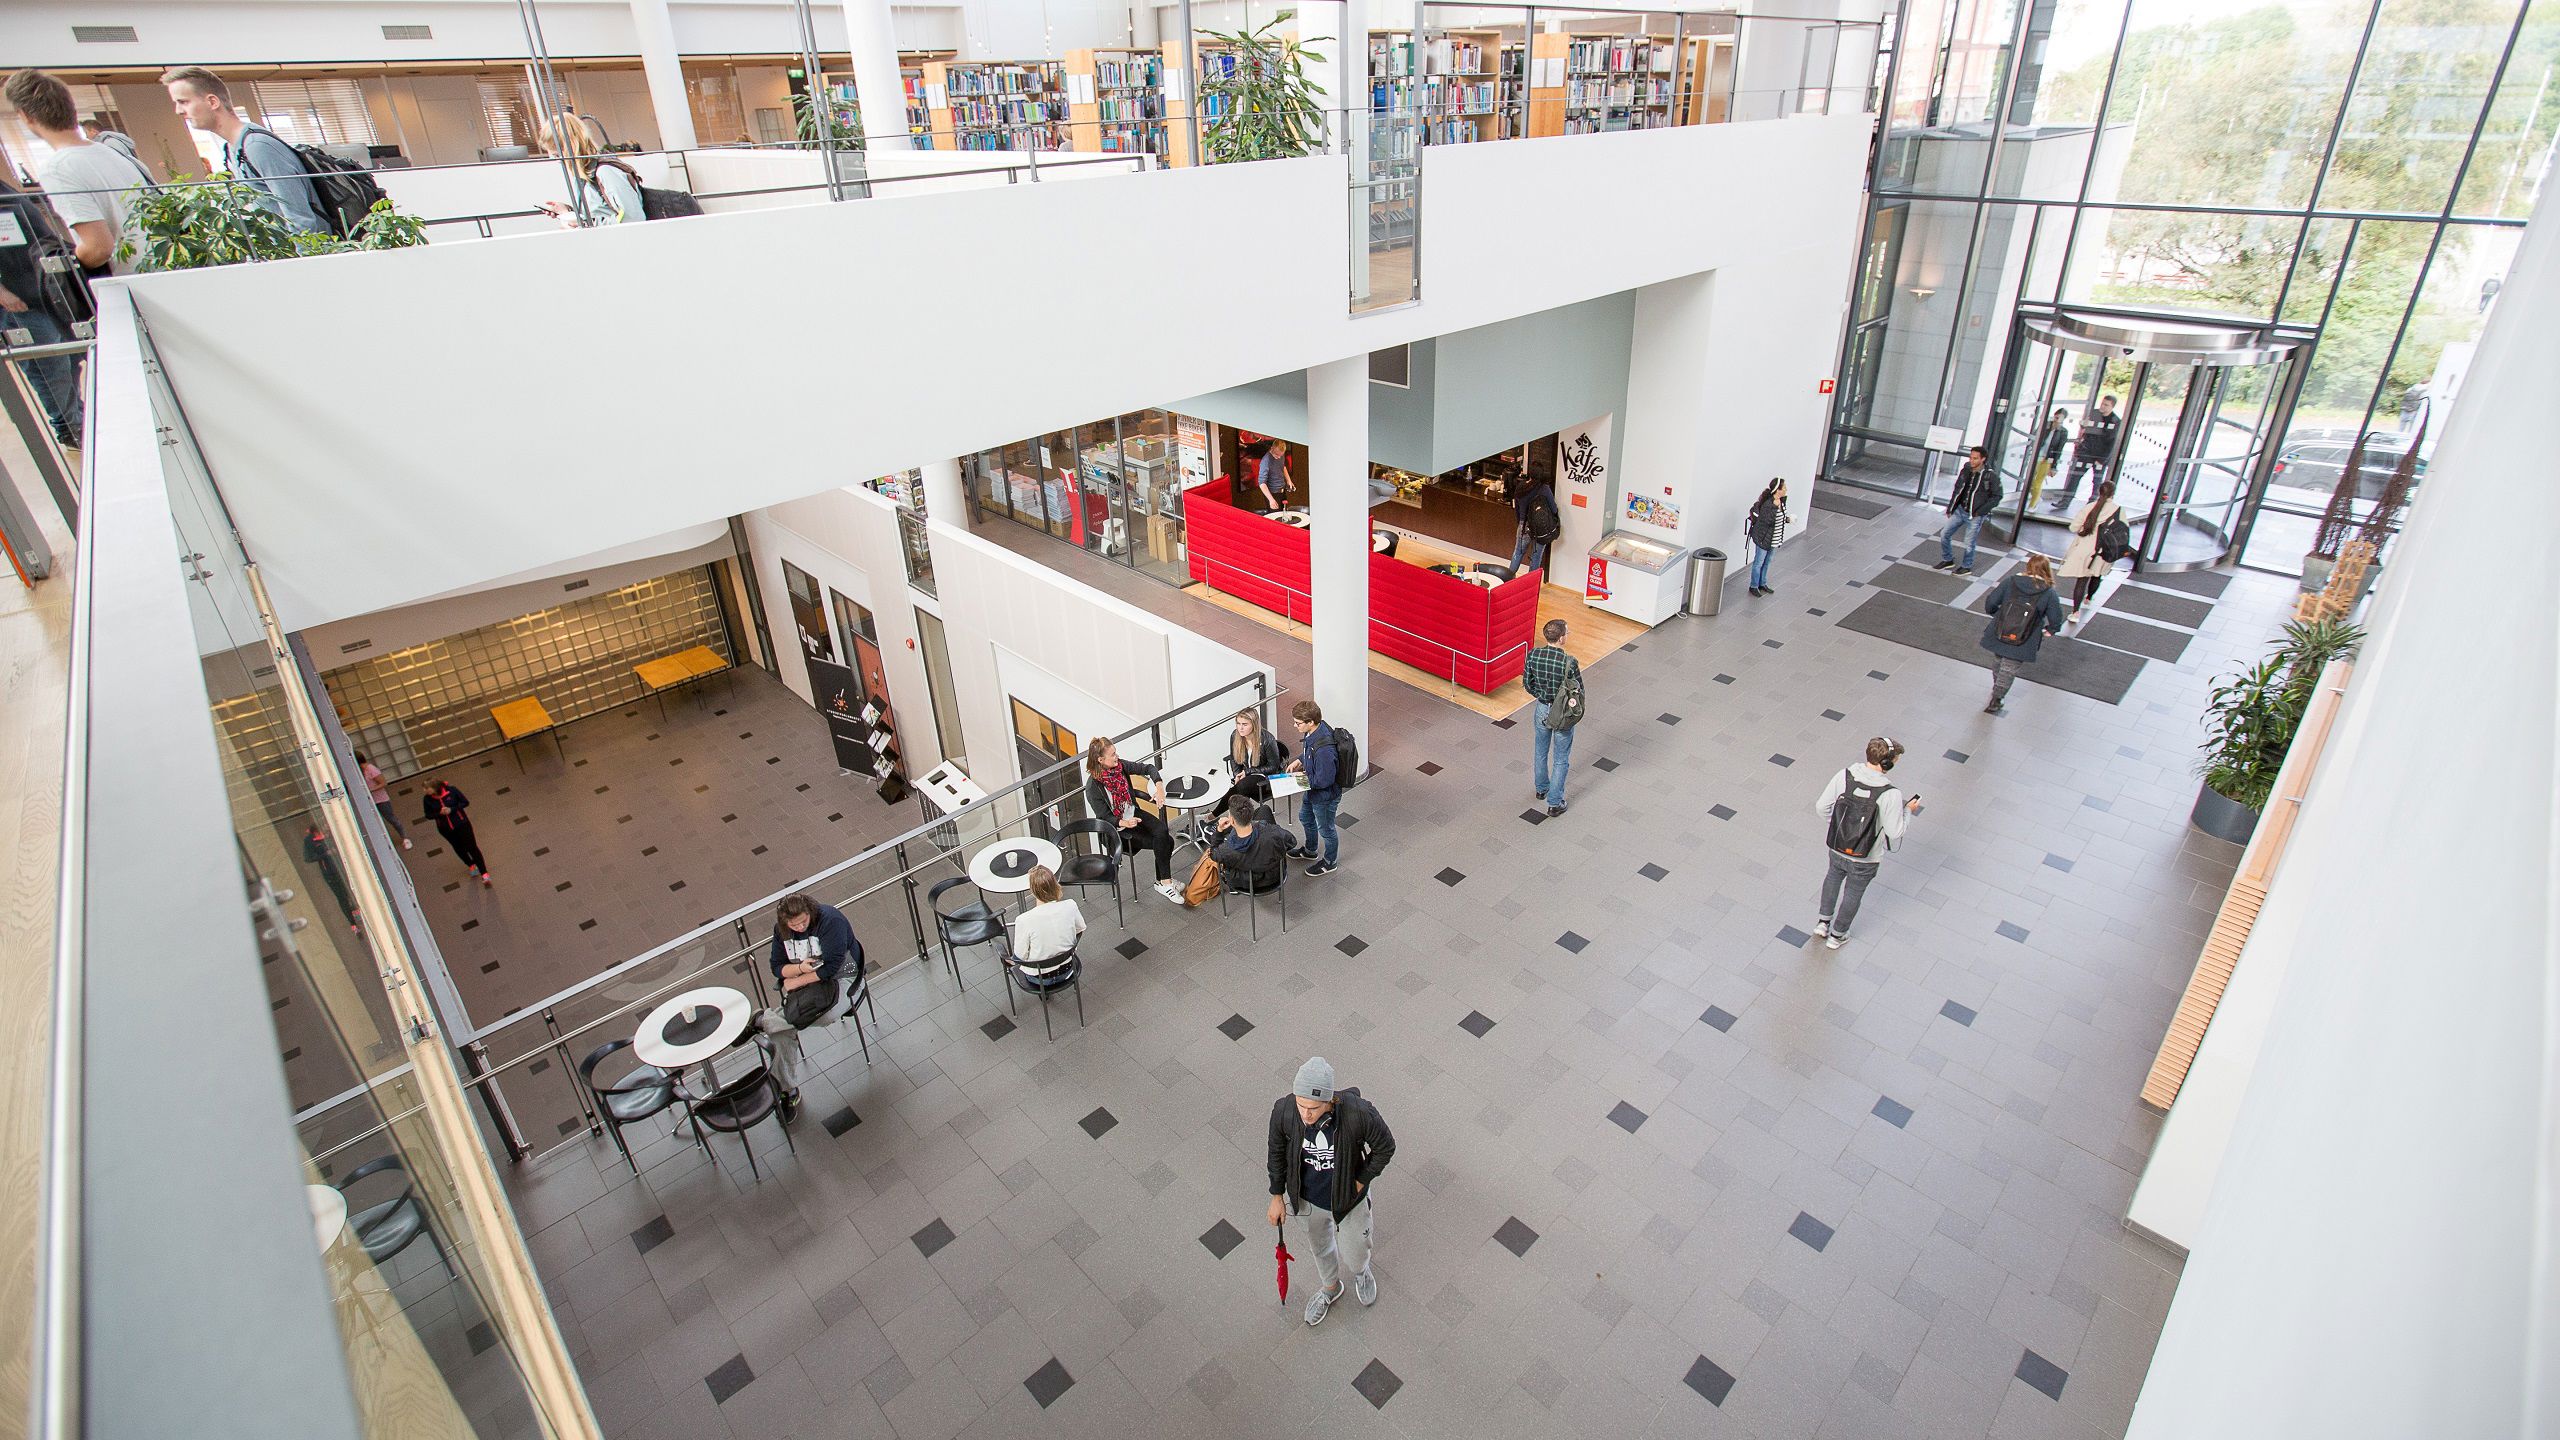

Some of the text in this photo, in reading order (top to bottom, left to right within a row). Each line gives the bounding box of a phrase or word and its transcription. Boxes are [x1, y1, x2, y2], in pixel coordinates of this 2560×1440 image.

[1560, 441, 1604, 477] Kaffe
[1568, 467, 1595, 484] Baren
[1304, 1158, 1335, 1171] adid
